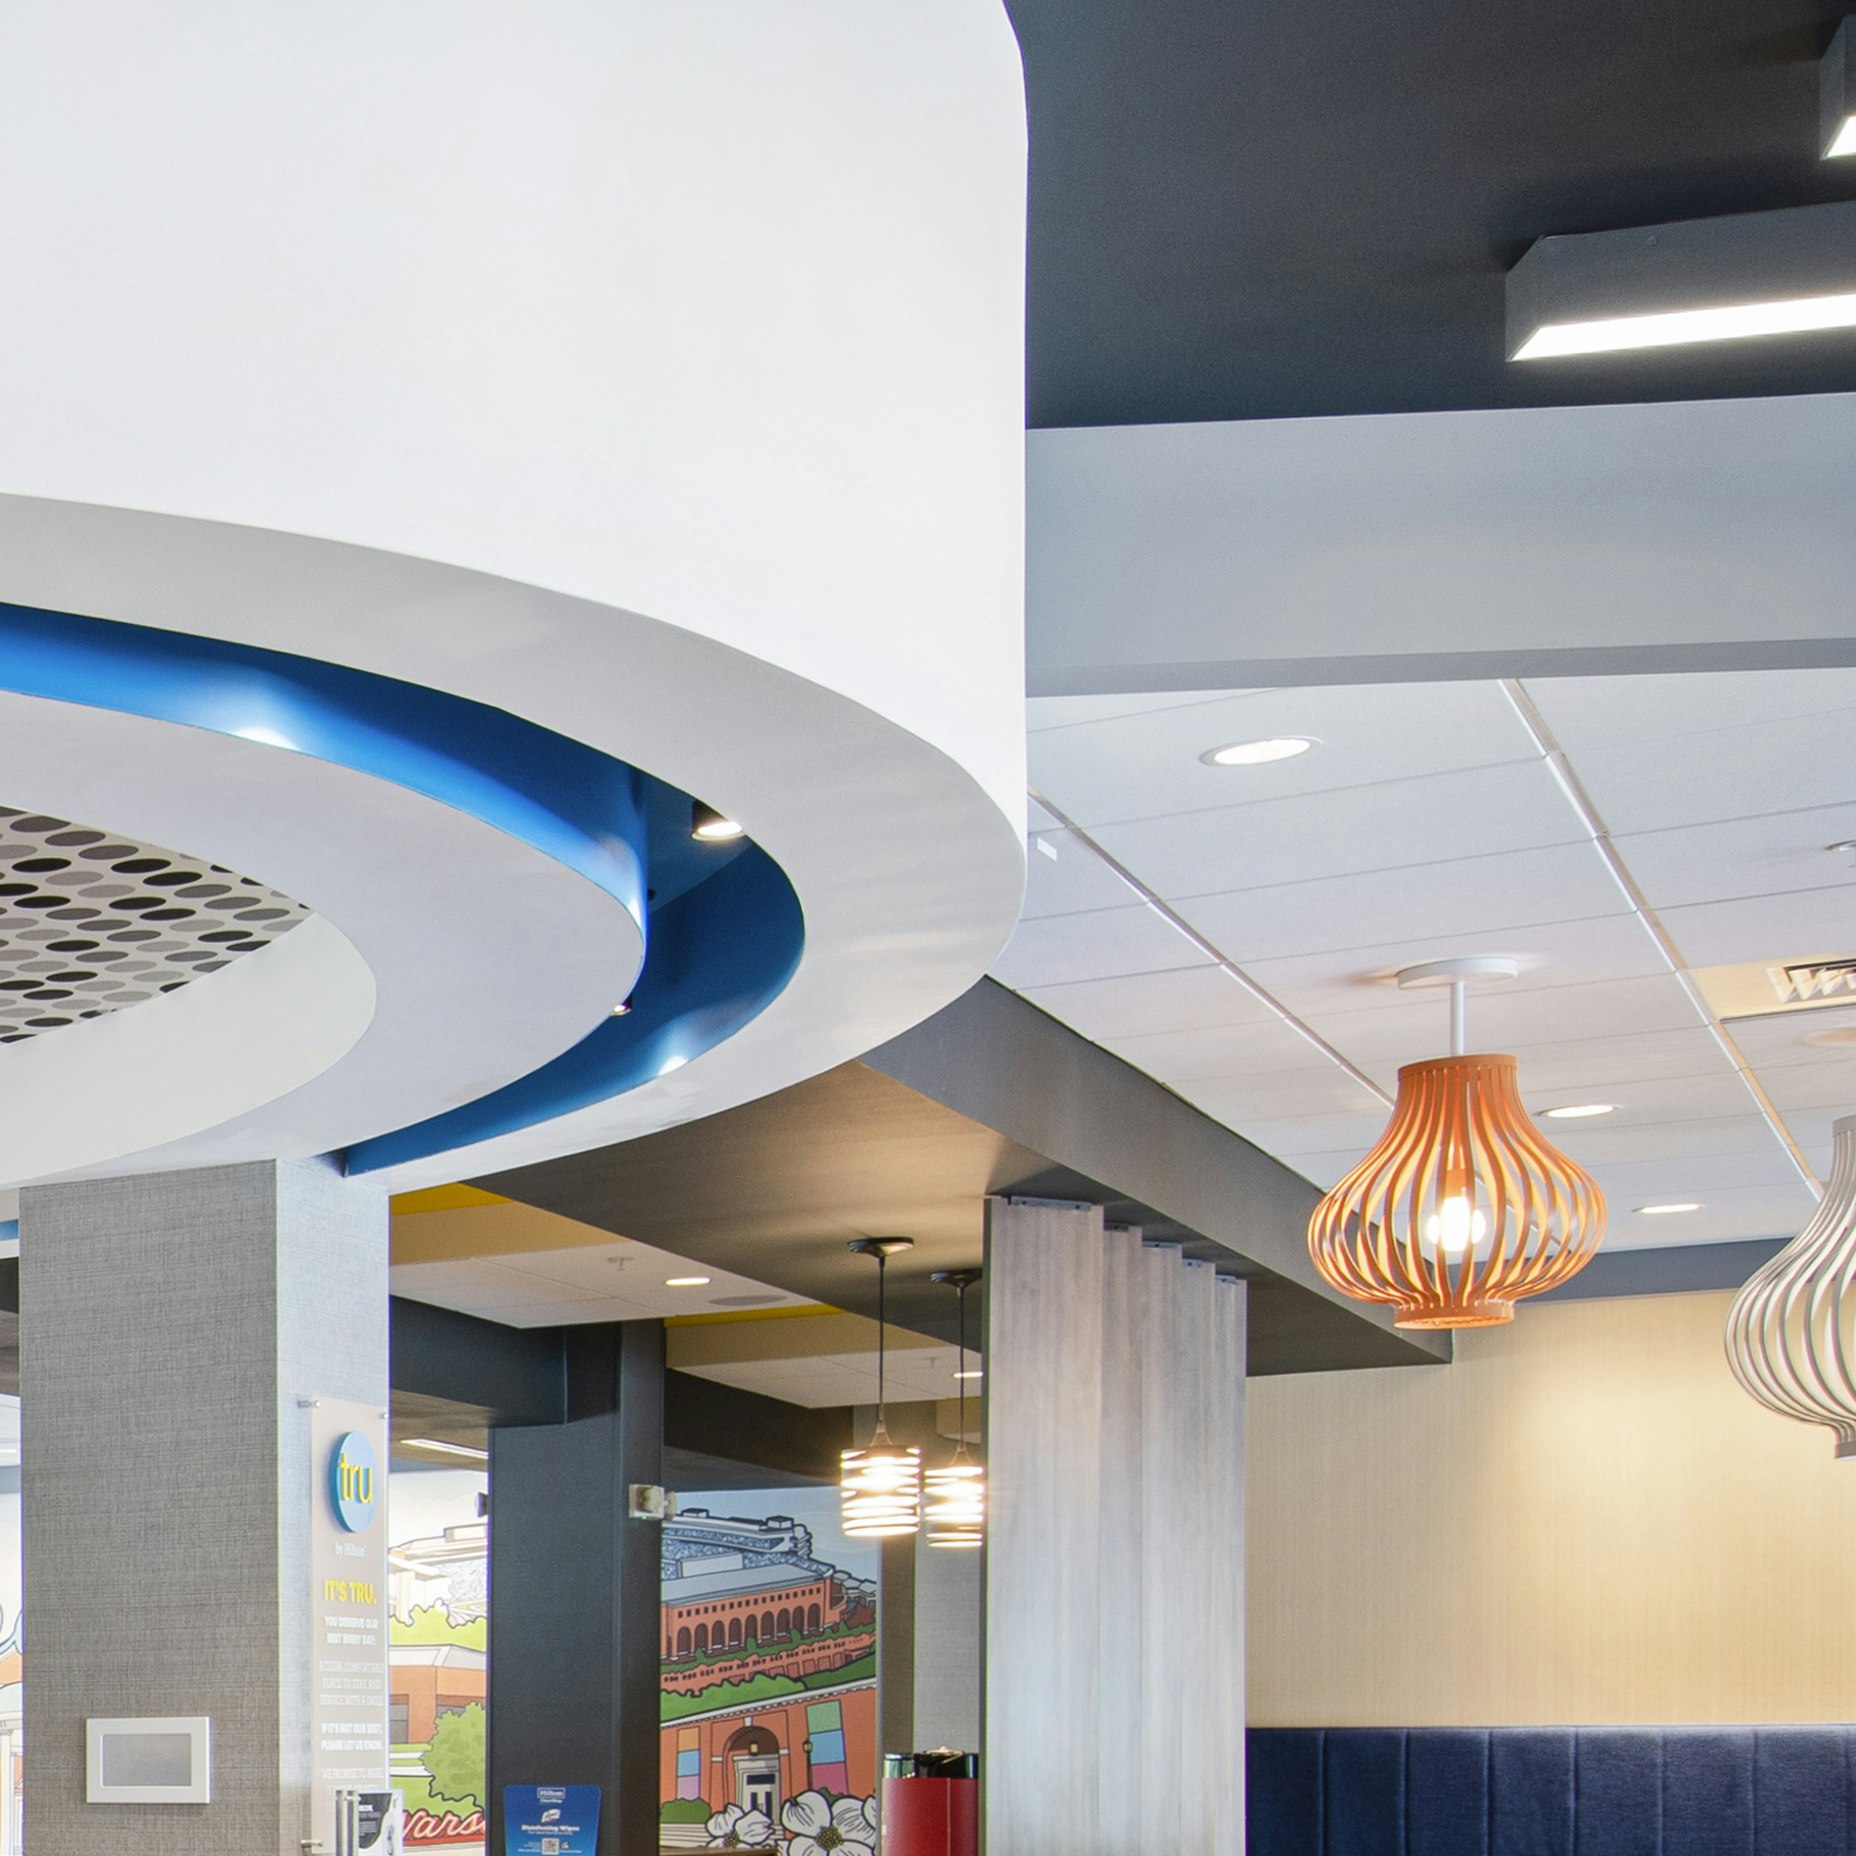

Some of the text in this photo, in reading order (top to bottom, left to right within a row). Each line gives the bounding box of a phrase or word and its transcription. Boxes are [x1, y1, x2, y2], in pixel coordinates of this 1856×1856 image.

[337, 1452, 373, 1504] tru
[324, 1580, 377, 1605] IT'S TRU.
[402, 1808, 486, 1841] Vars
